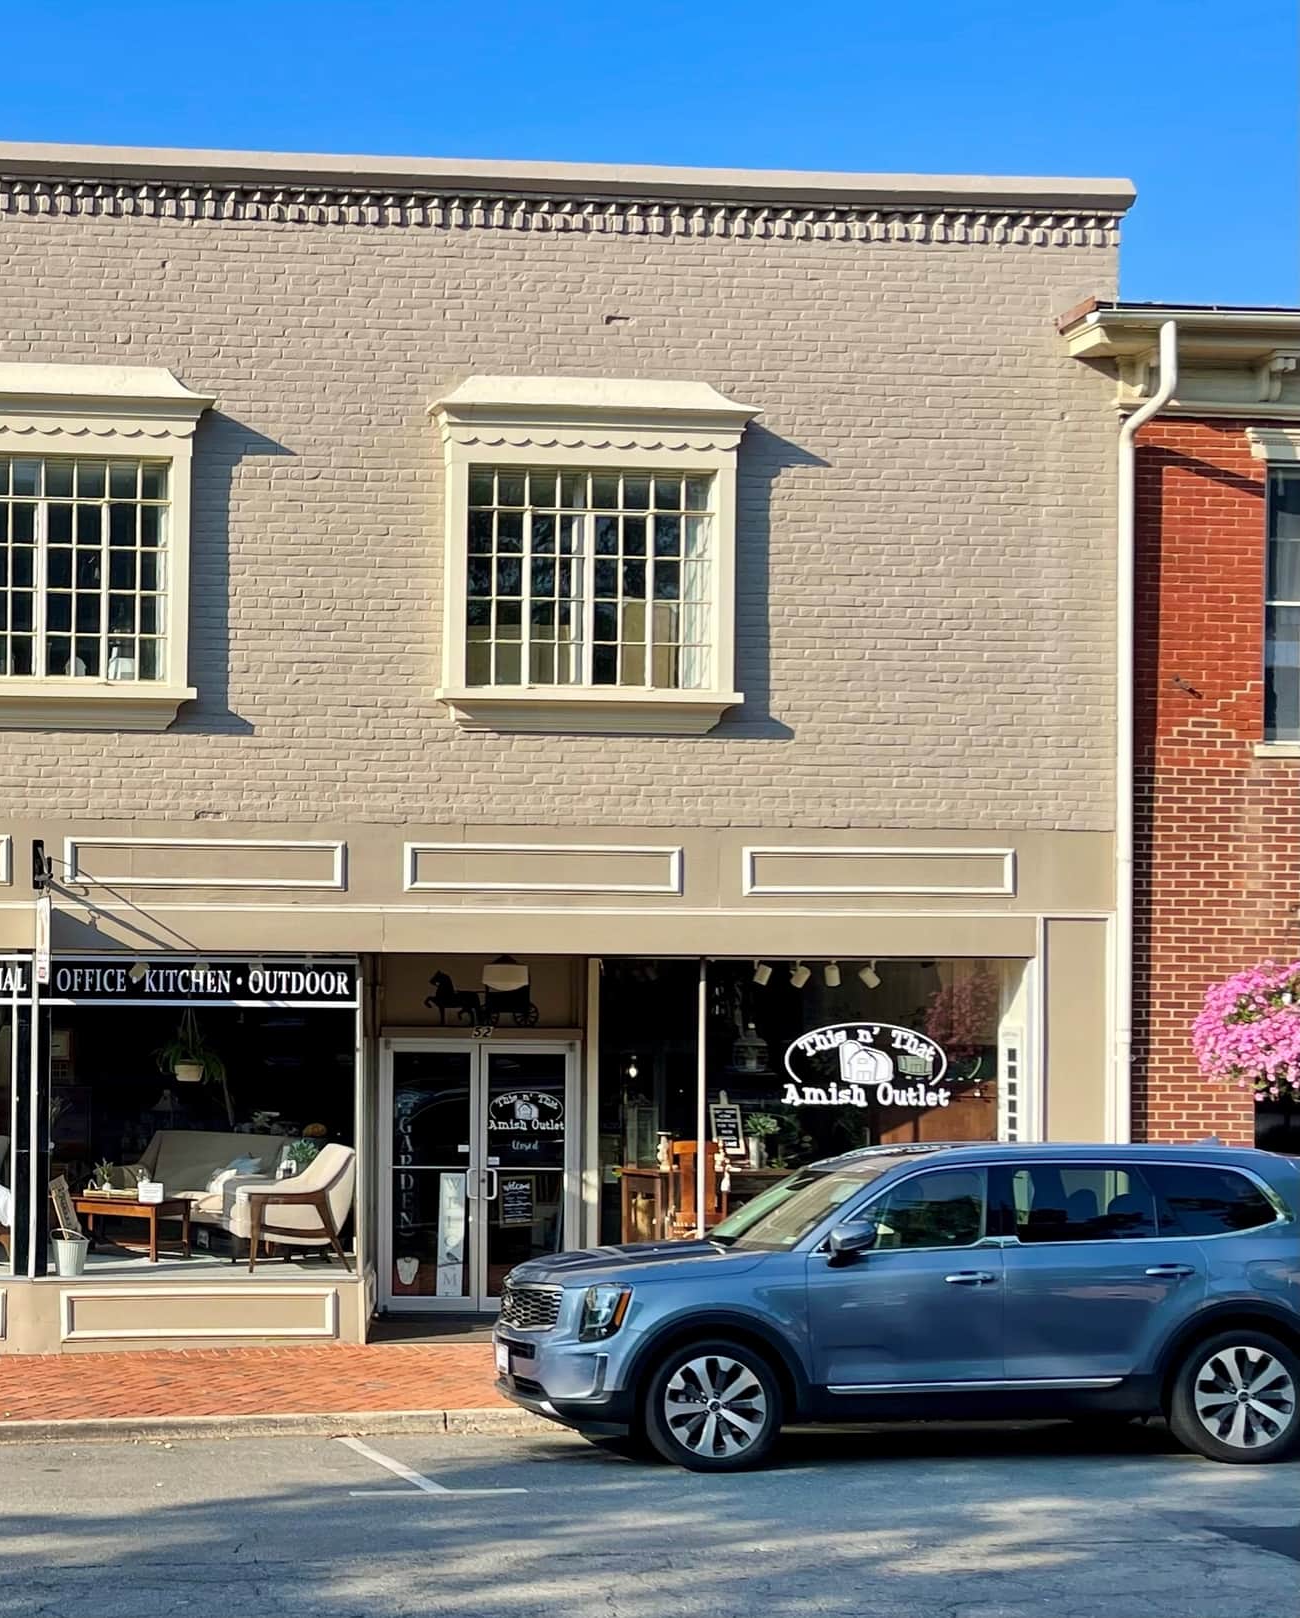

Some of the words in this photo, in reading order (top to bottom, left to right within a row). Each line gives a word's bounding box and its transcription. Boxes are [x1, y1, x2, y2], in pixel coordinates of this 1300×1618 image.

[56, 968, 127, 993] OFFICE
[143, 969, 231, 994] KITCHEN
[249, 970, 350, 995] OUTDOOR
[473, 1026, 492, 1038] 52
[797, 1029, 847, 1057] This
[890, 1029, 936, 1062] That
[495, 1093, 518, 1108] This
[537, 1094, 558, 1110] That
[781, 1082, 868, 1107] Amish
[876, 1082, 951, 1107] Outlet
[488, 1118, 528, 1131] Amish
[531, 1118, 565, 1131] Outlet
